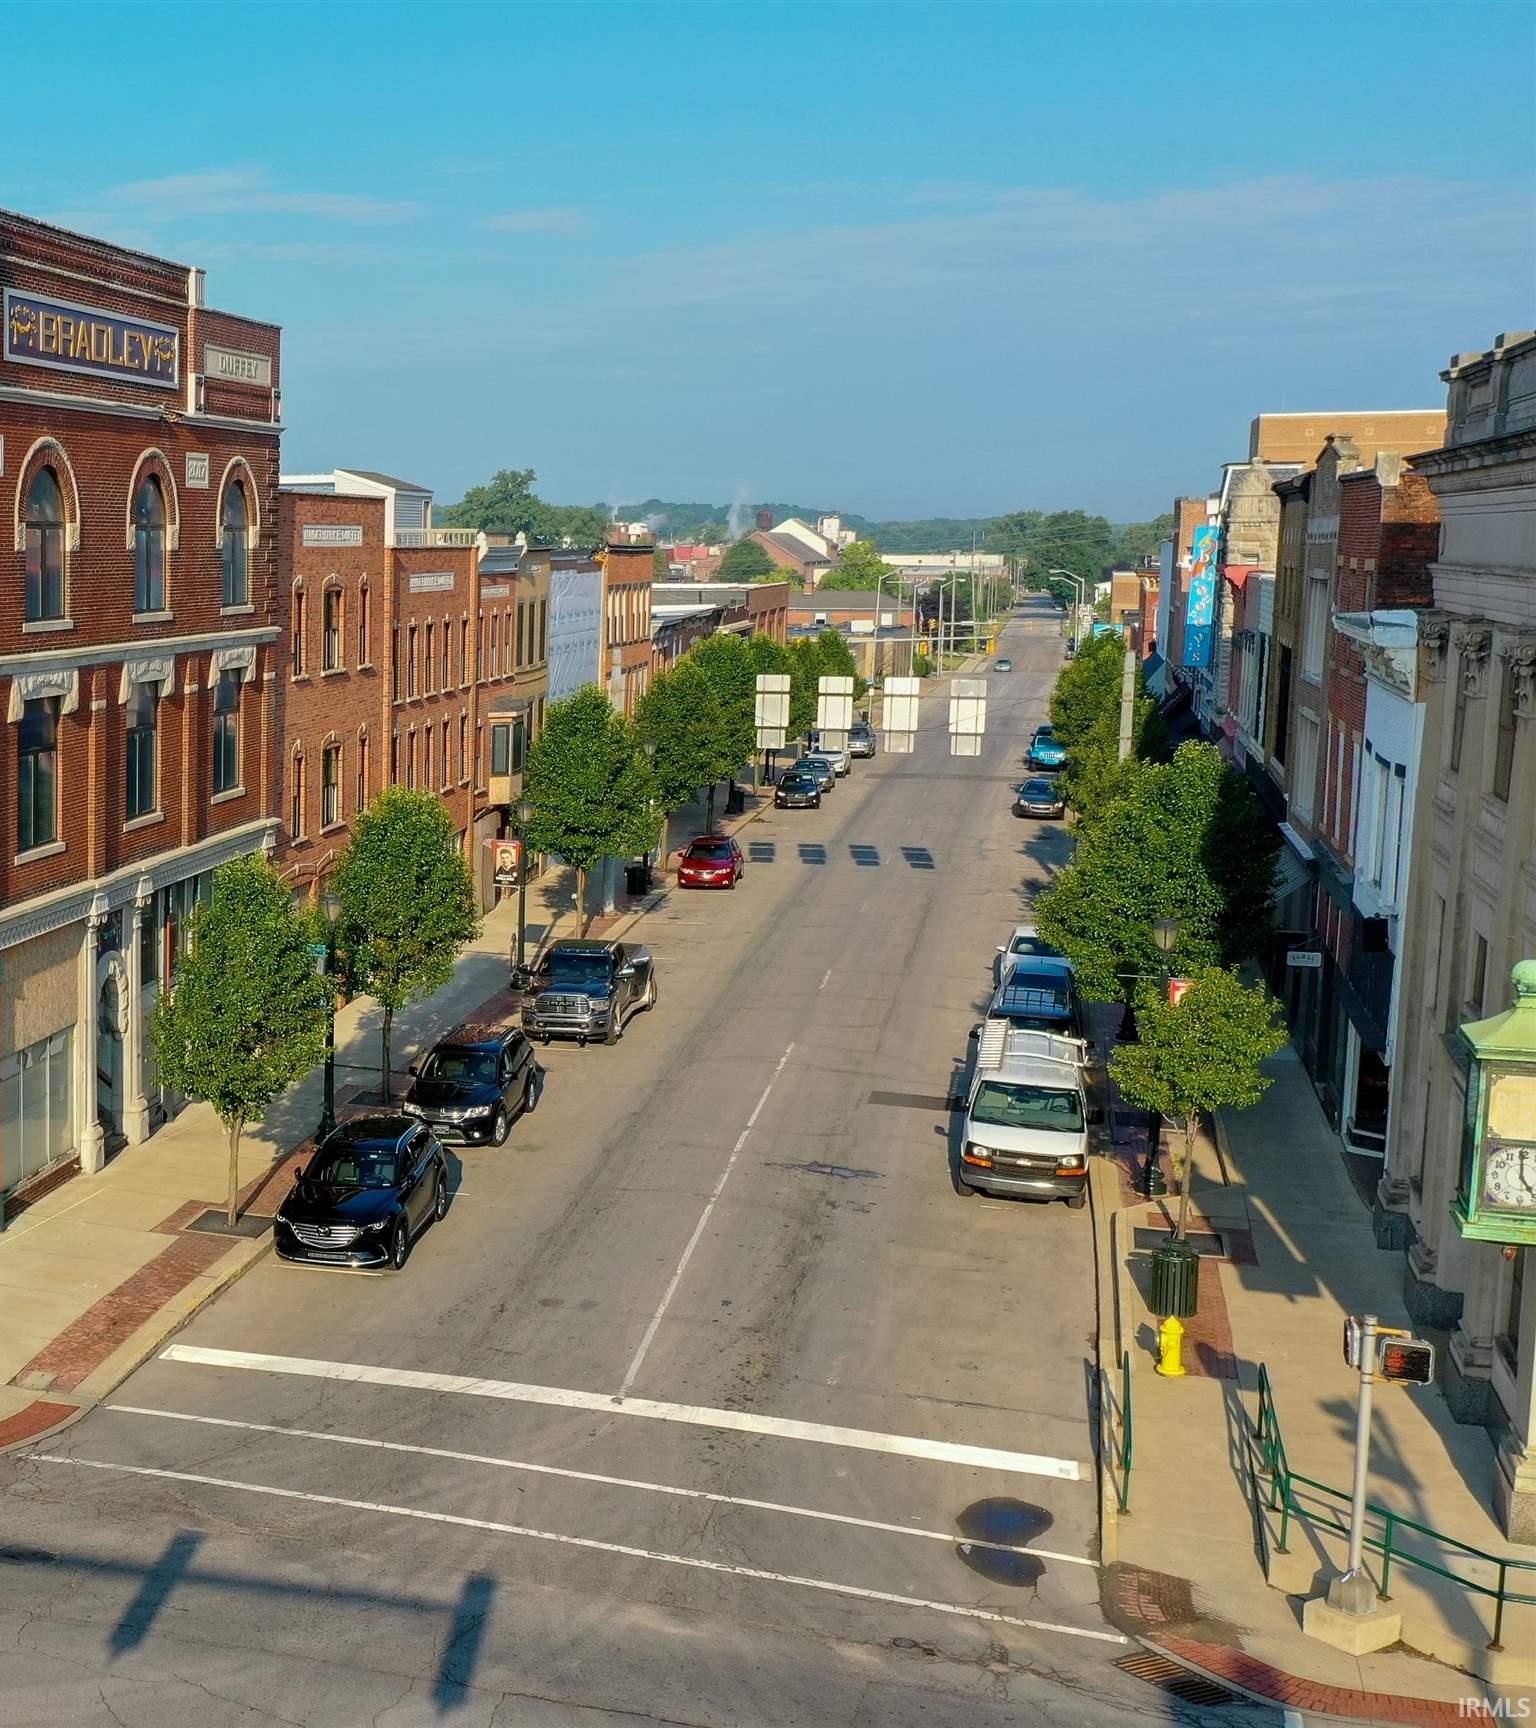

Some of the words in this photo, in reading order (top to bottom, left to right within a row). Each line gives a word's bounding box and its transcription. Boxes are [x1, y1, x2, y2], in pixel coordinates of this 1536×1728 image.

[39, 310, 154, 371] BRADLEY
[218, 355, 259, 379] DUFFEY
[1495, 1160, 1506, 1169] 10
